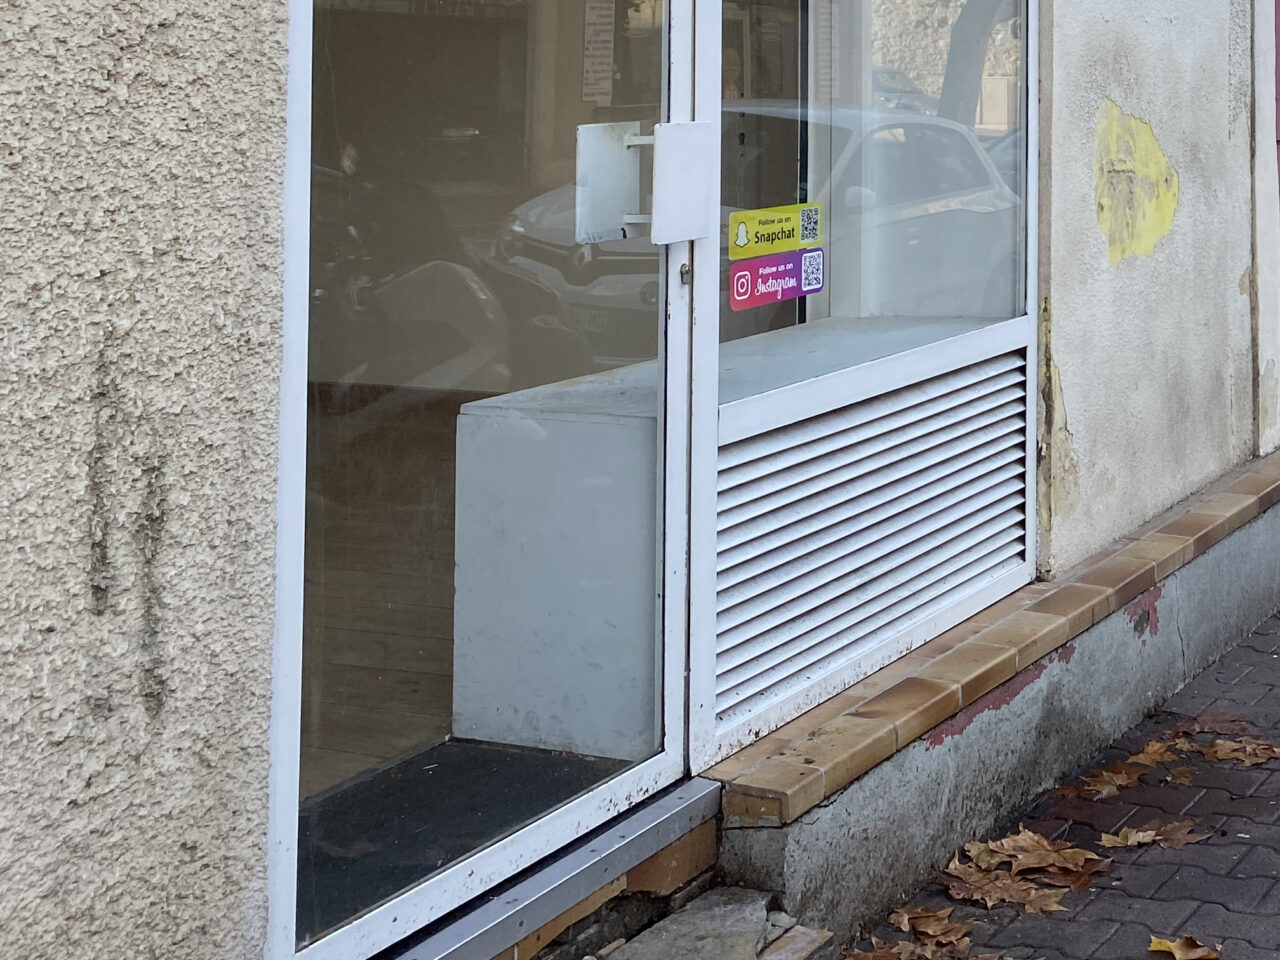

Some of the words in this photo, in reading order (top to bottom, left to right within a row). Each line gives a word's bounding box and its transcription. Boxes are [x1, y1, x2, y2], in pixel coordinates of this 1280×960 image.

[754, 227, 795, 244] Snapchat
[759, 265, 777, 275] Follow
[754, 276, 797, 299] Instagram
